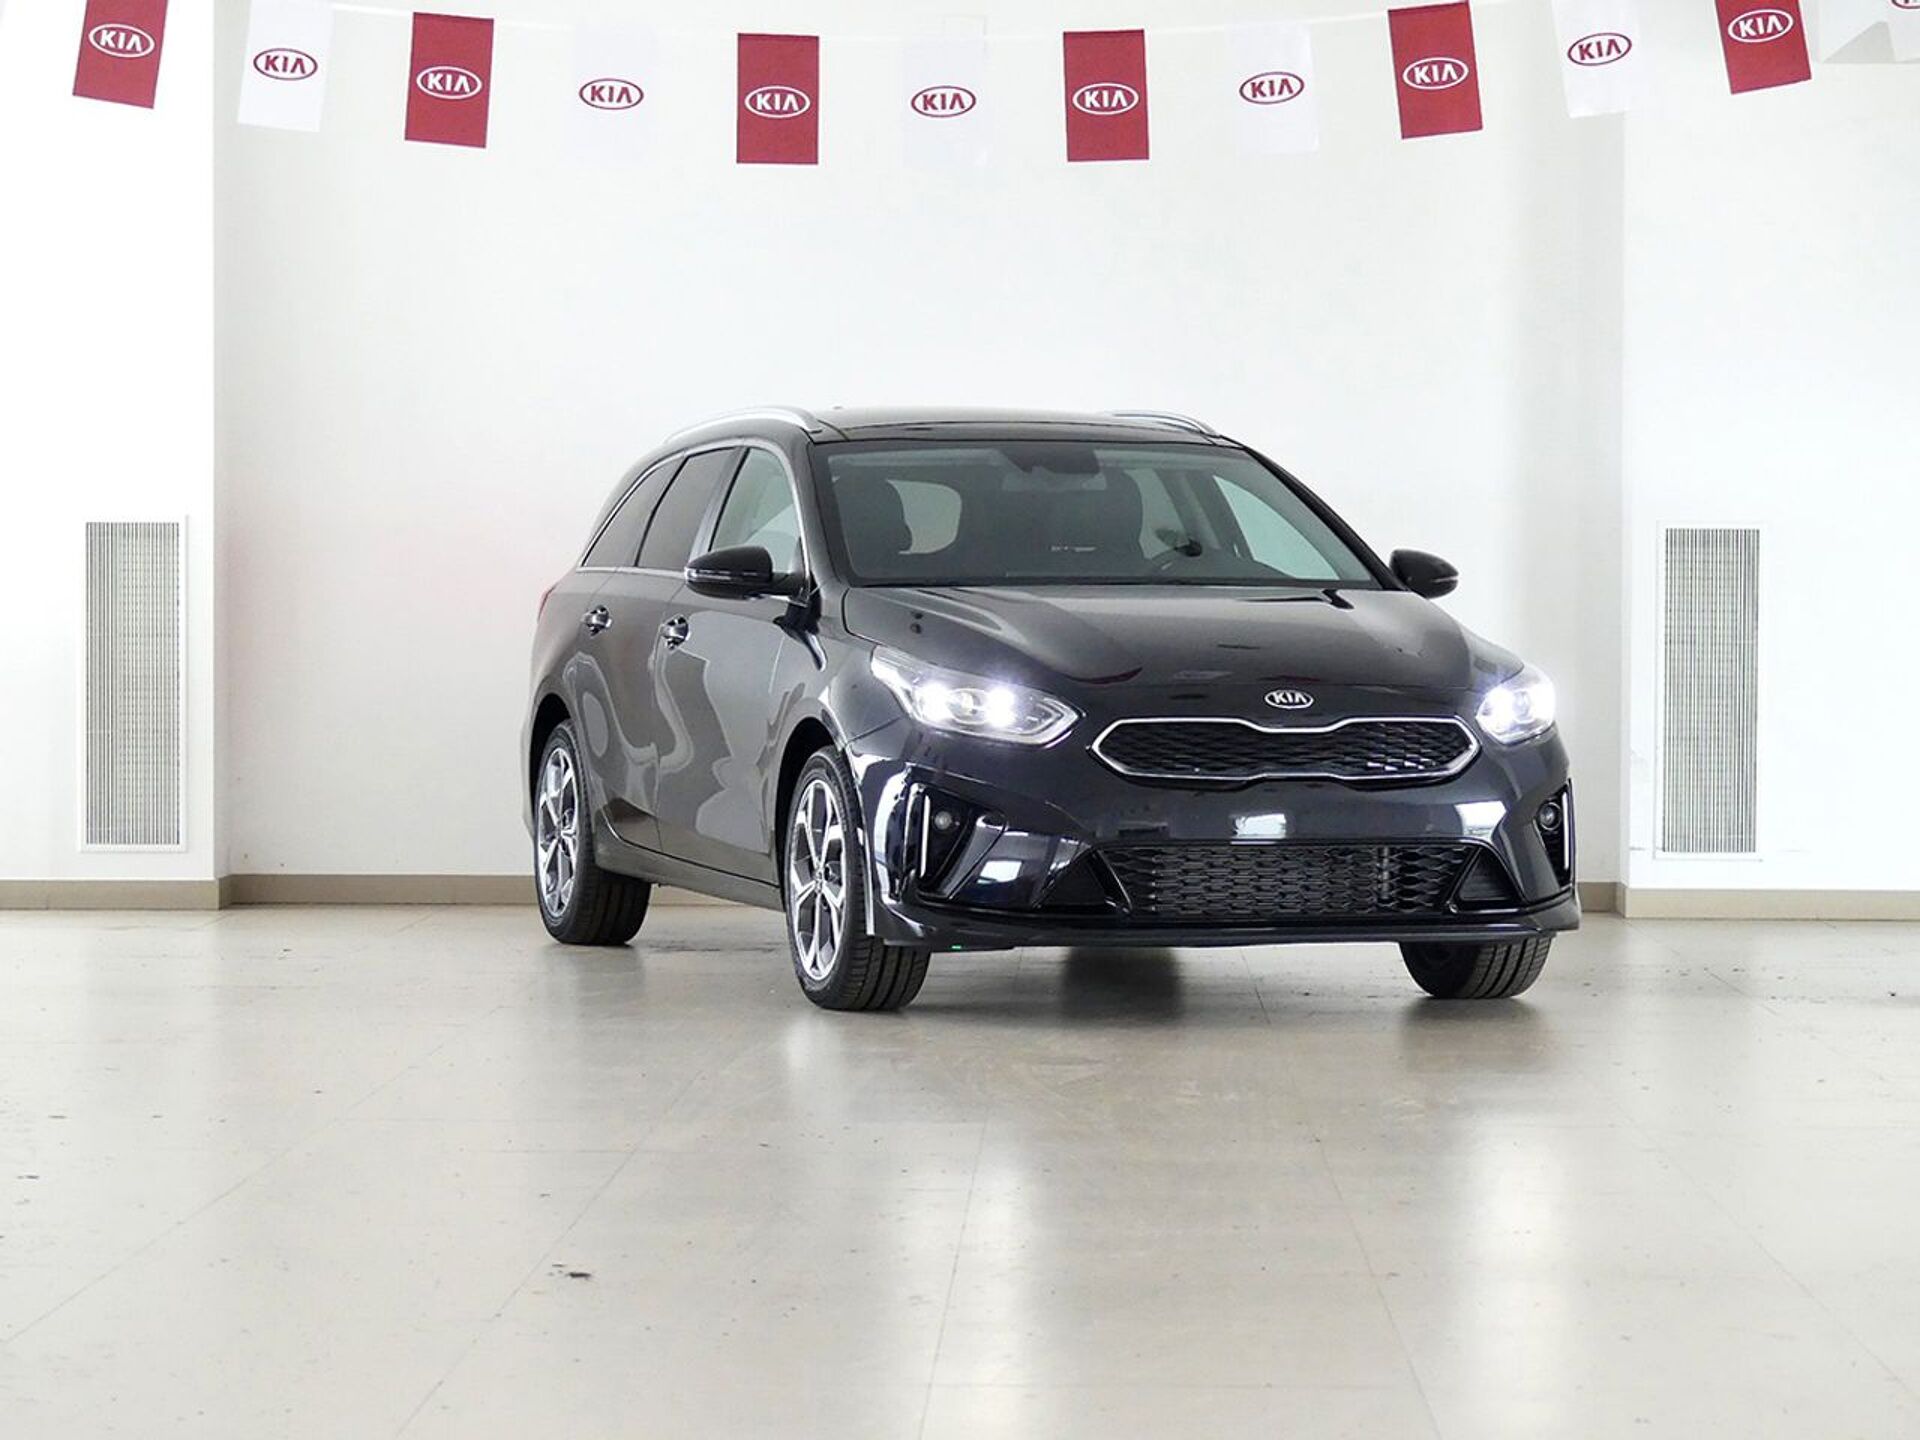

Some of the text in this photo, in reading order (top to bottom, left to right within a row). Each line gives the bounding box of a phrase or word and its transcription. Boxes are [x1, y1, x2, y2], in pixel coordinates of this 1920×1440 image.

[1738, 14, 1784, 38] KIA
[99, 29, 144, 52] KIA
[1577, 38, 1622, 61] KIA
[263, 54, 307, 75] KIA
[1412, 63, 1459, 85] KIA
[426, 72, 472, 94] KIA
[589, 84, 634, 104] KIA
[1250, 77, 1294, 99] KIA
[754, 91, 800, 112] KIA
[921, 92, 966, 112] KIA
[1082, 88, 1128, 109] KIA
